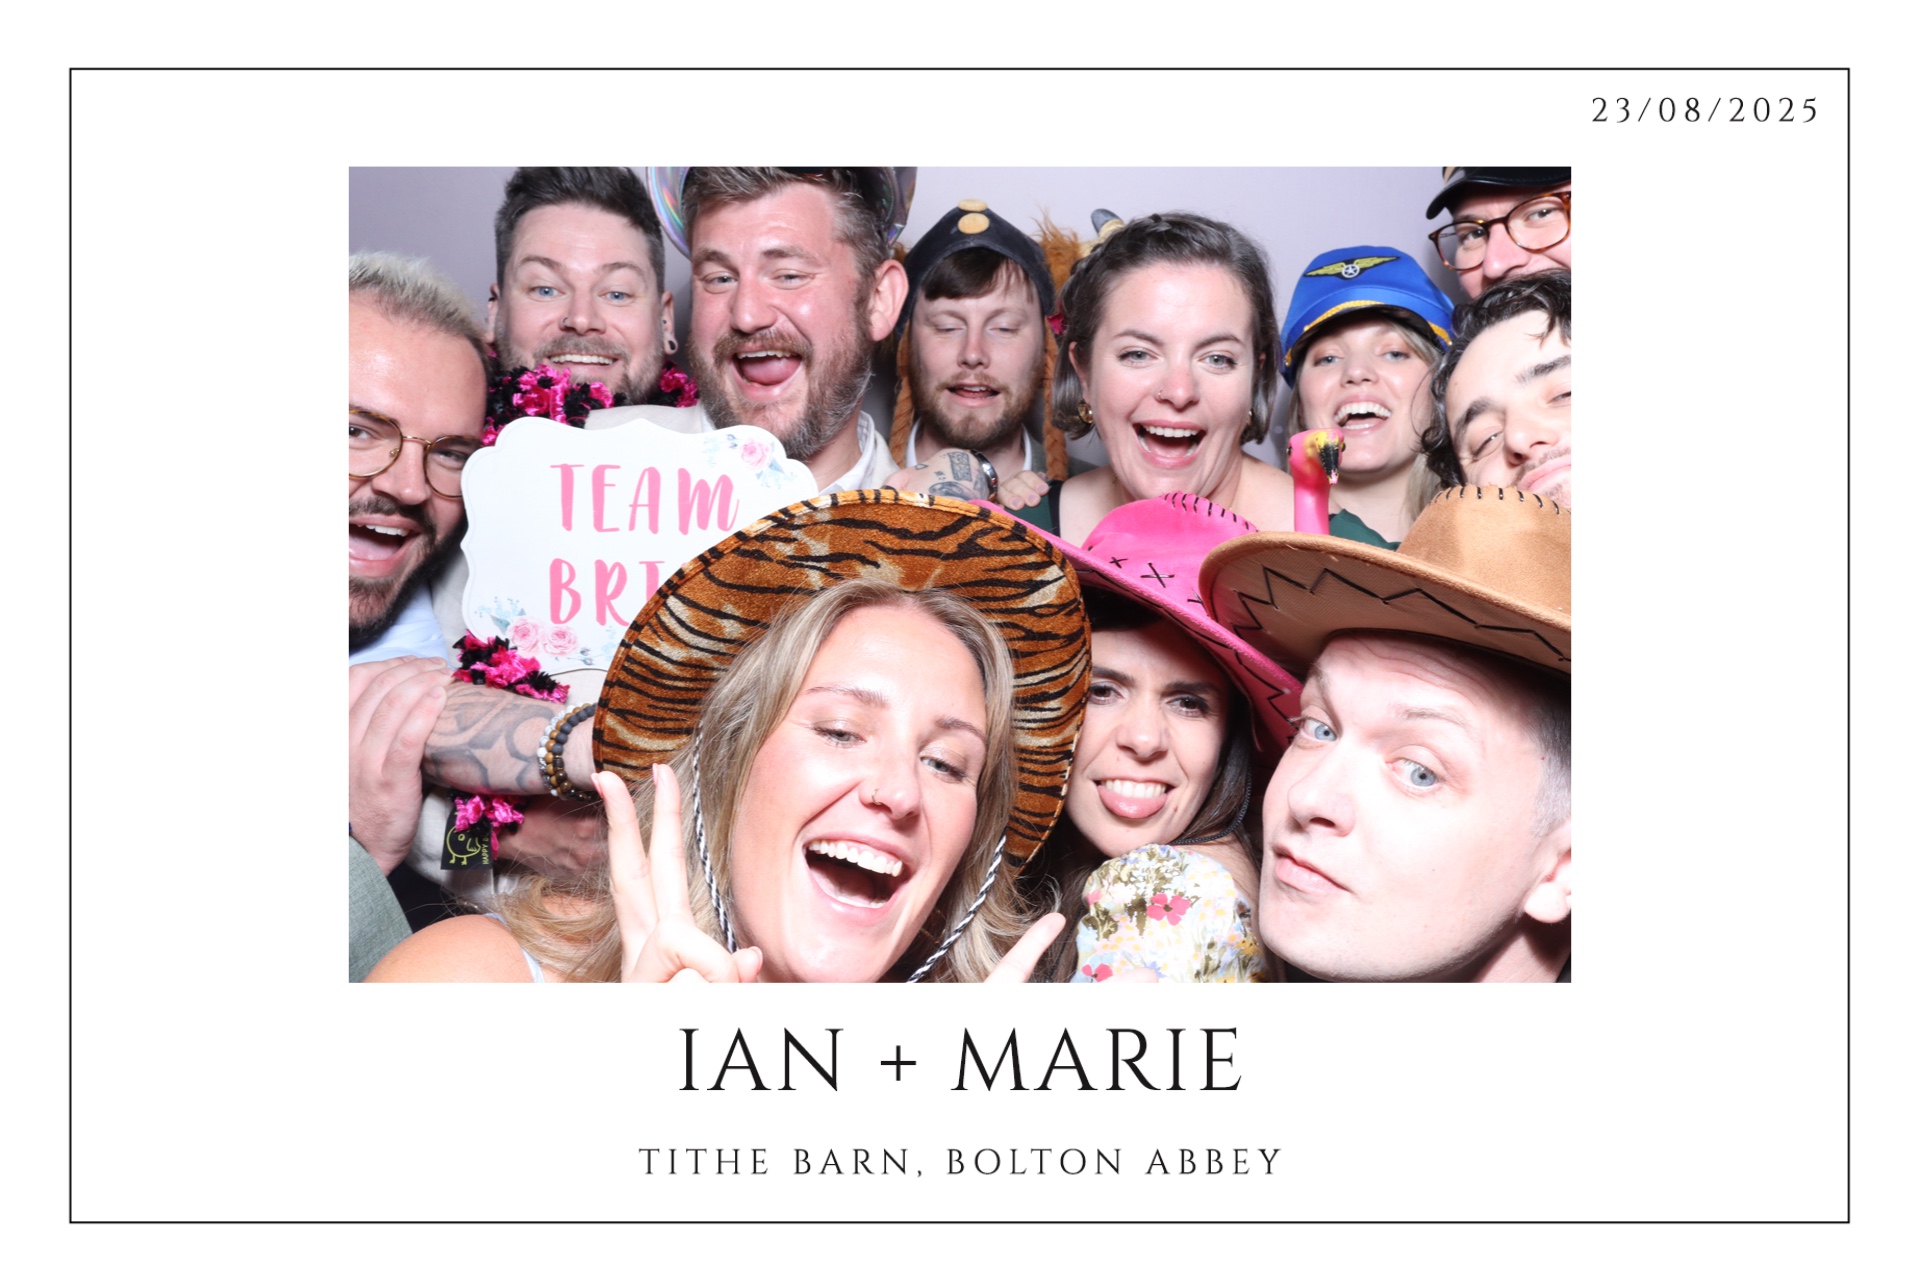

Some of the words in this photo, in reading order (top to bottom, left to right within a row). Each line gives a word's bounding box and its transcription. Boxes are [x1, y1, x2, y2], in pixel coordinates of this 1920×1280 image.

[550, 463, 740, 536] TEAM
[549, 557, 687, 627] BRI
[481, 843, 490, 865] HAPPY
